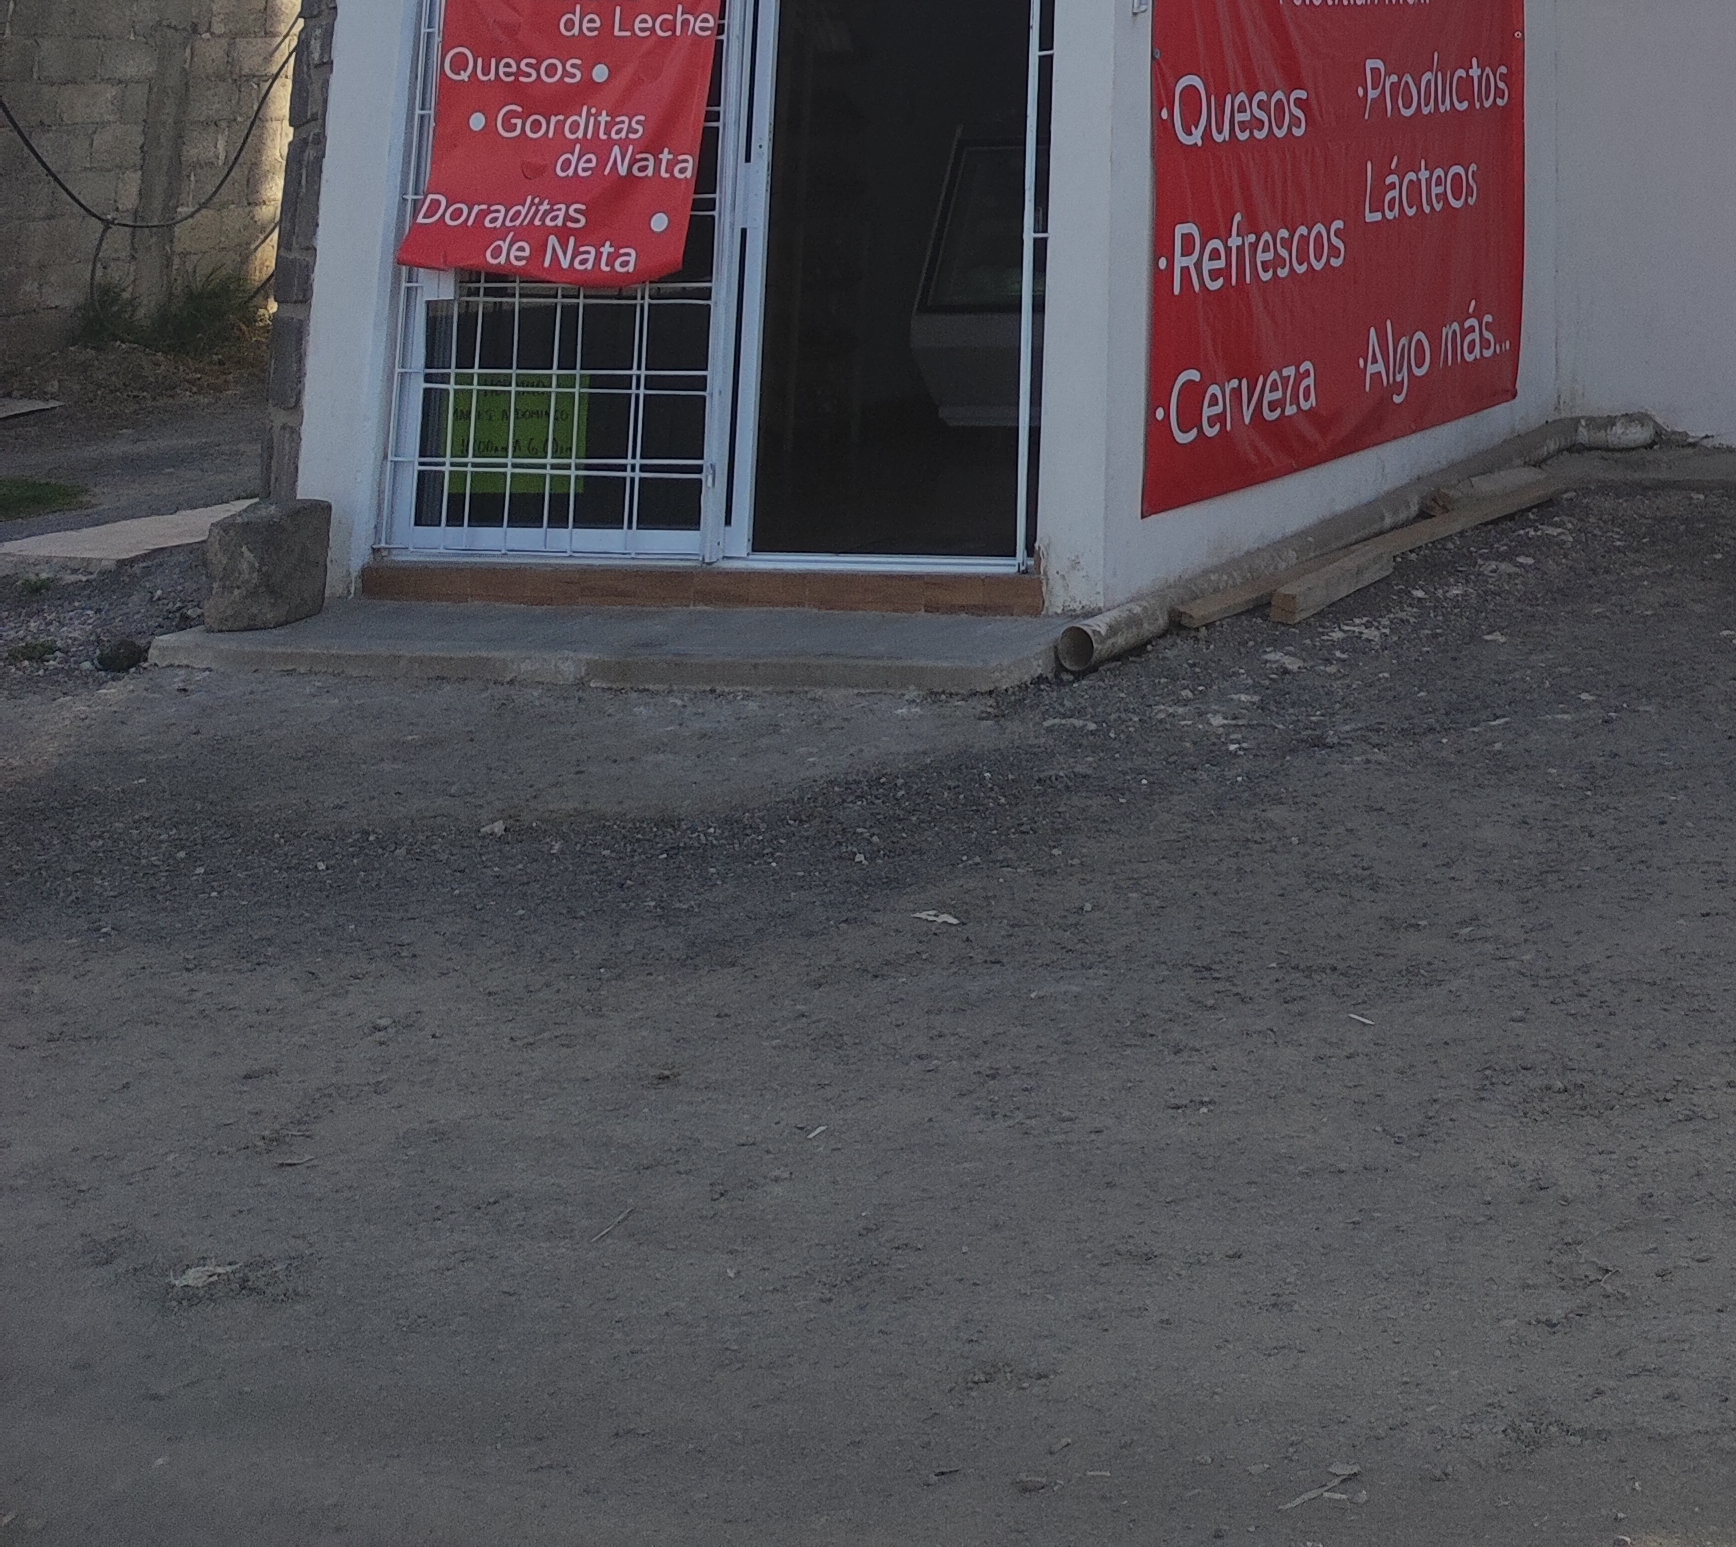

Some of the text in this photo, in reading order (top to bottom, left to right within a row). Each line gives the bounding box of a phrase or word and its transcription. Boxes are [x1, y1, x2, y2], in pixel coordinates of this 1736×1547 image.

[559, 4, 715, 37] de Leche
[443, 47, 583, 83] Quesos
[1173, 51, 1509, 146] Quesos Productos
[496, 104, 645, 140] Gorditas
[555, 143, 695, 179] de Nata
[1364, 155, 1477, 222] Lácteos
[416, 193, 587, 228] Doraditas
[485, 232, 637, 273] de Nata
[1173, 212, 1346, 295] Refrescos
[1364, 299, 1511, 403] Algo más...
[1169, 360, 1317, 444] Cerveza
